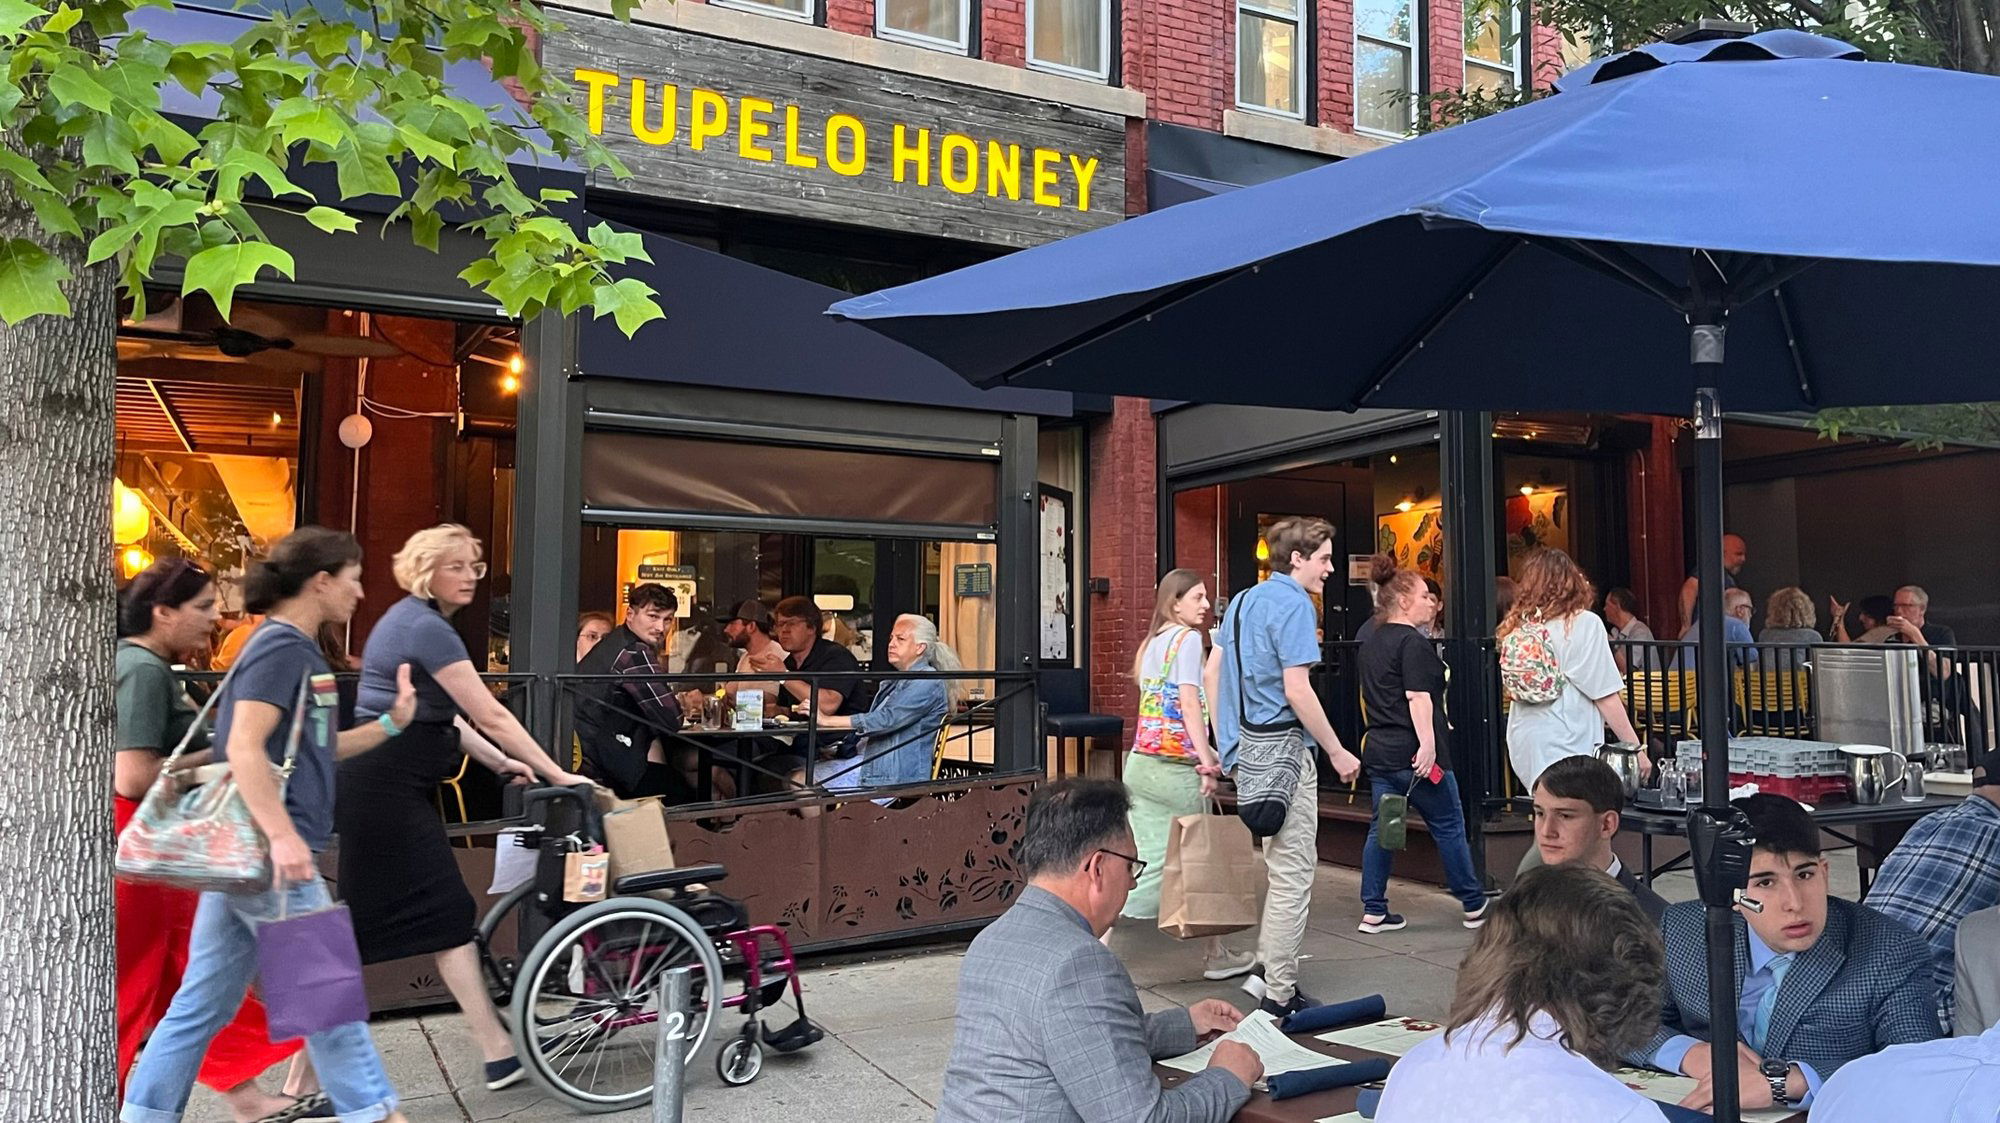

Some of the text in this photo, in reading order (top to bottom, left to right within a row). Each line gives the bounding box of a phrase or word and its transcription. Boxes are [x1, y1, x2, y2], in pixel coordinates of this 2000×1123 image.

[574, 67, 1098, 211] TUPELO HONEY
[666, 1011, 685, 1041] 2
